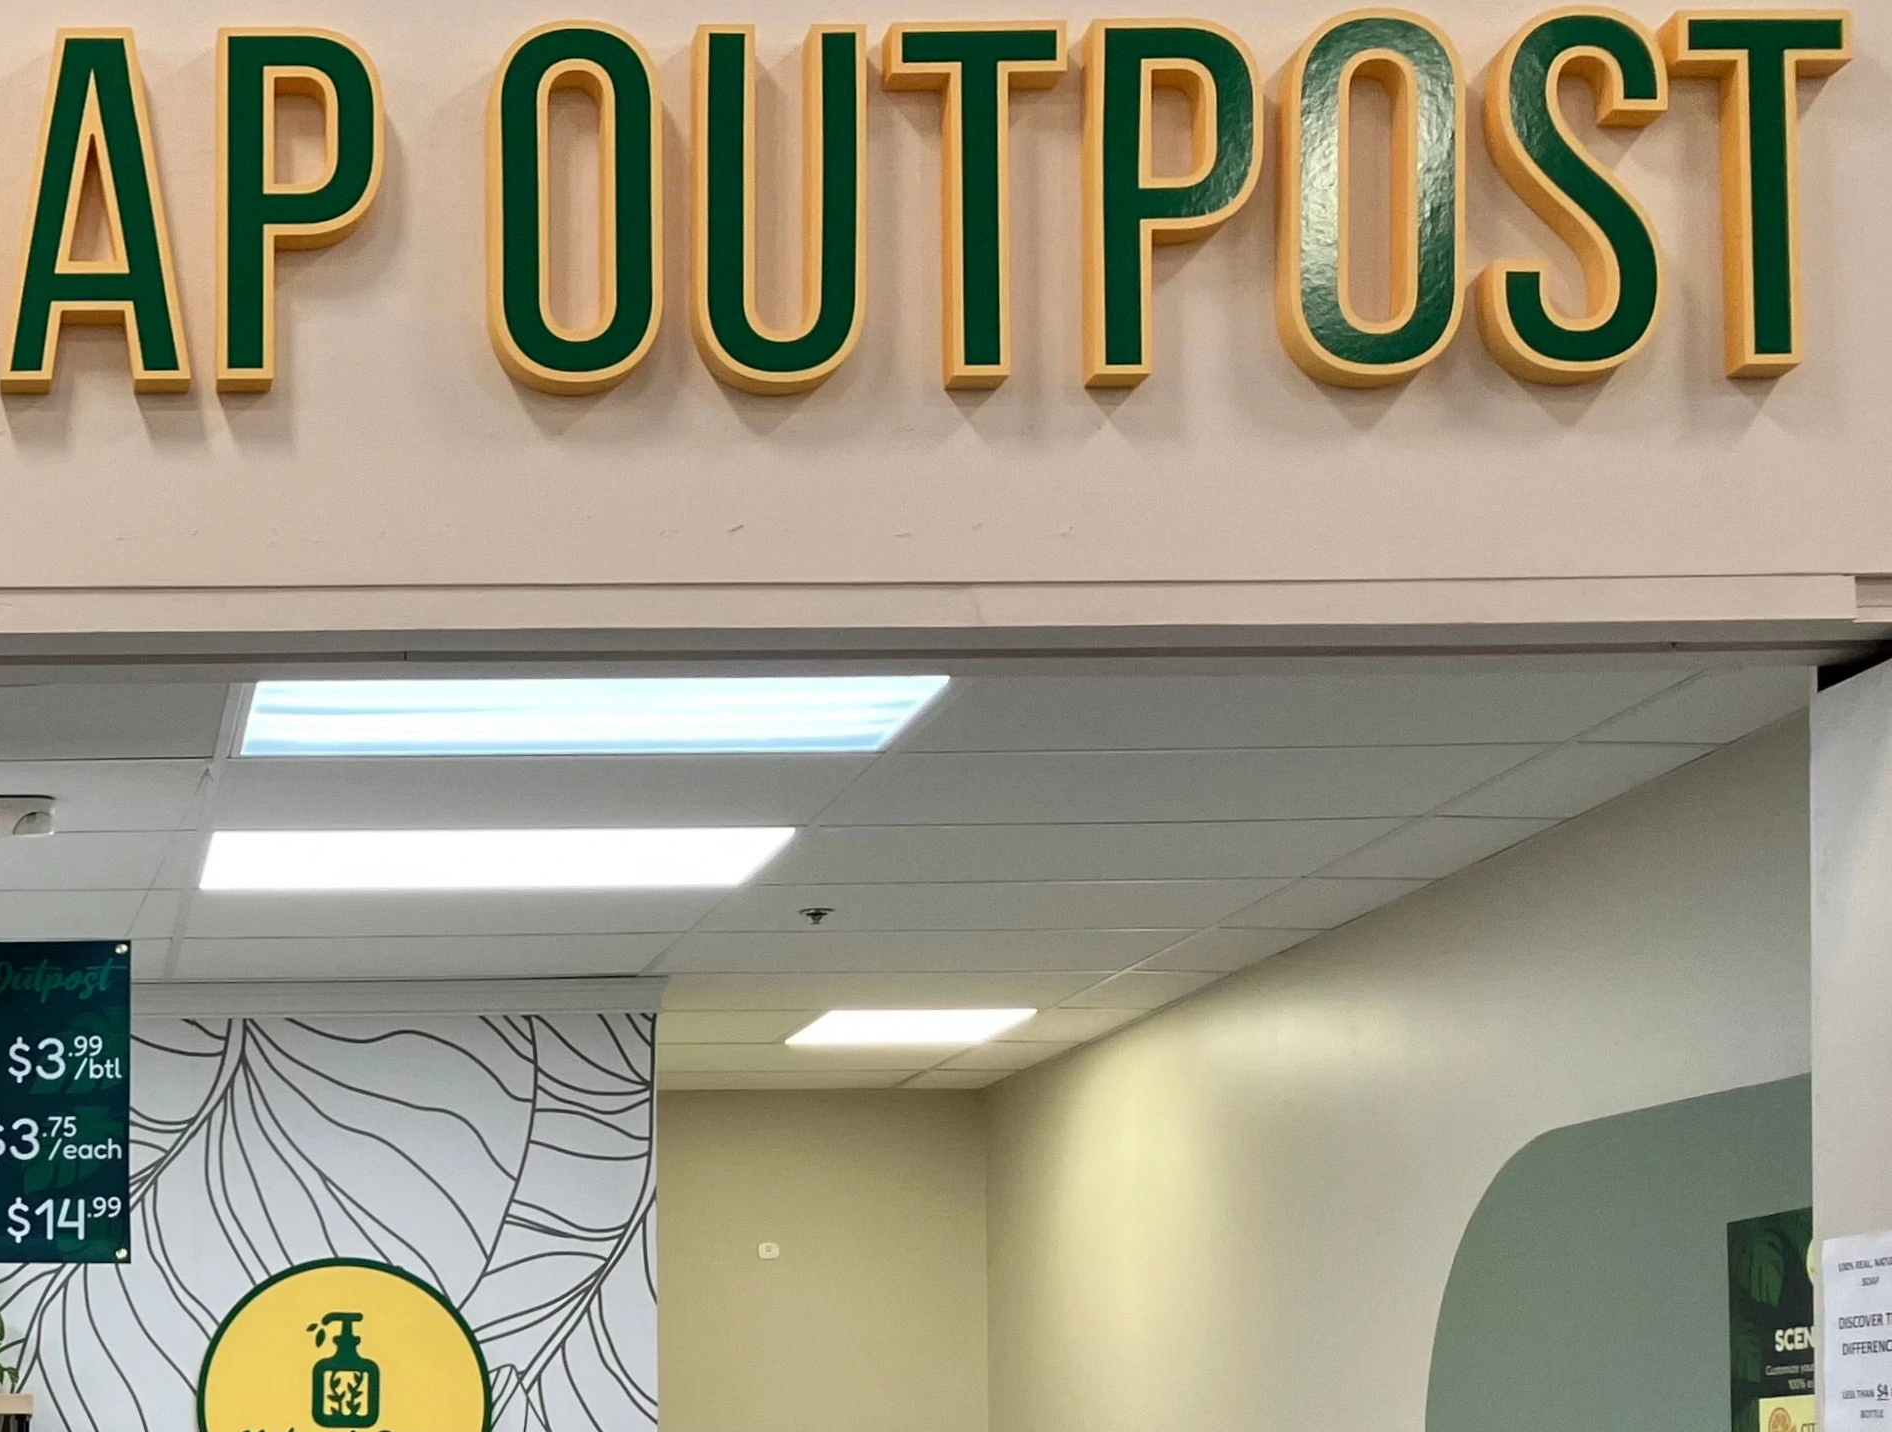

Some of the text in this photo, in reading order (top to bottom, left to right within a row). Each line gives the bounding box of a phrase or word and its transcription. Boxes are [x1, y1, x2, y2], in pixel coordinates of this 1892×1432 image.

[485, 8, 1852, 394] OUTPOST
[74, 1057, 123, 1081] /btl
[48, 1138, 122, 1161] /each
[1838, 1313, 1883, 1330] DISCOVER
[1877, 1383, 1888, 1399] $4
